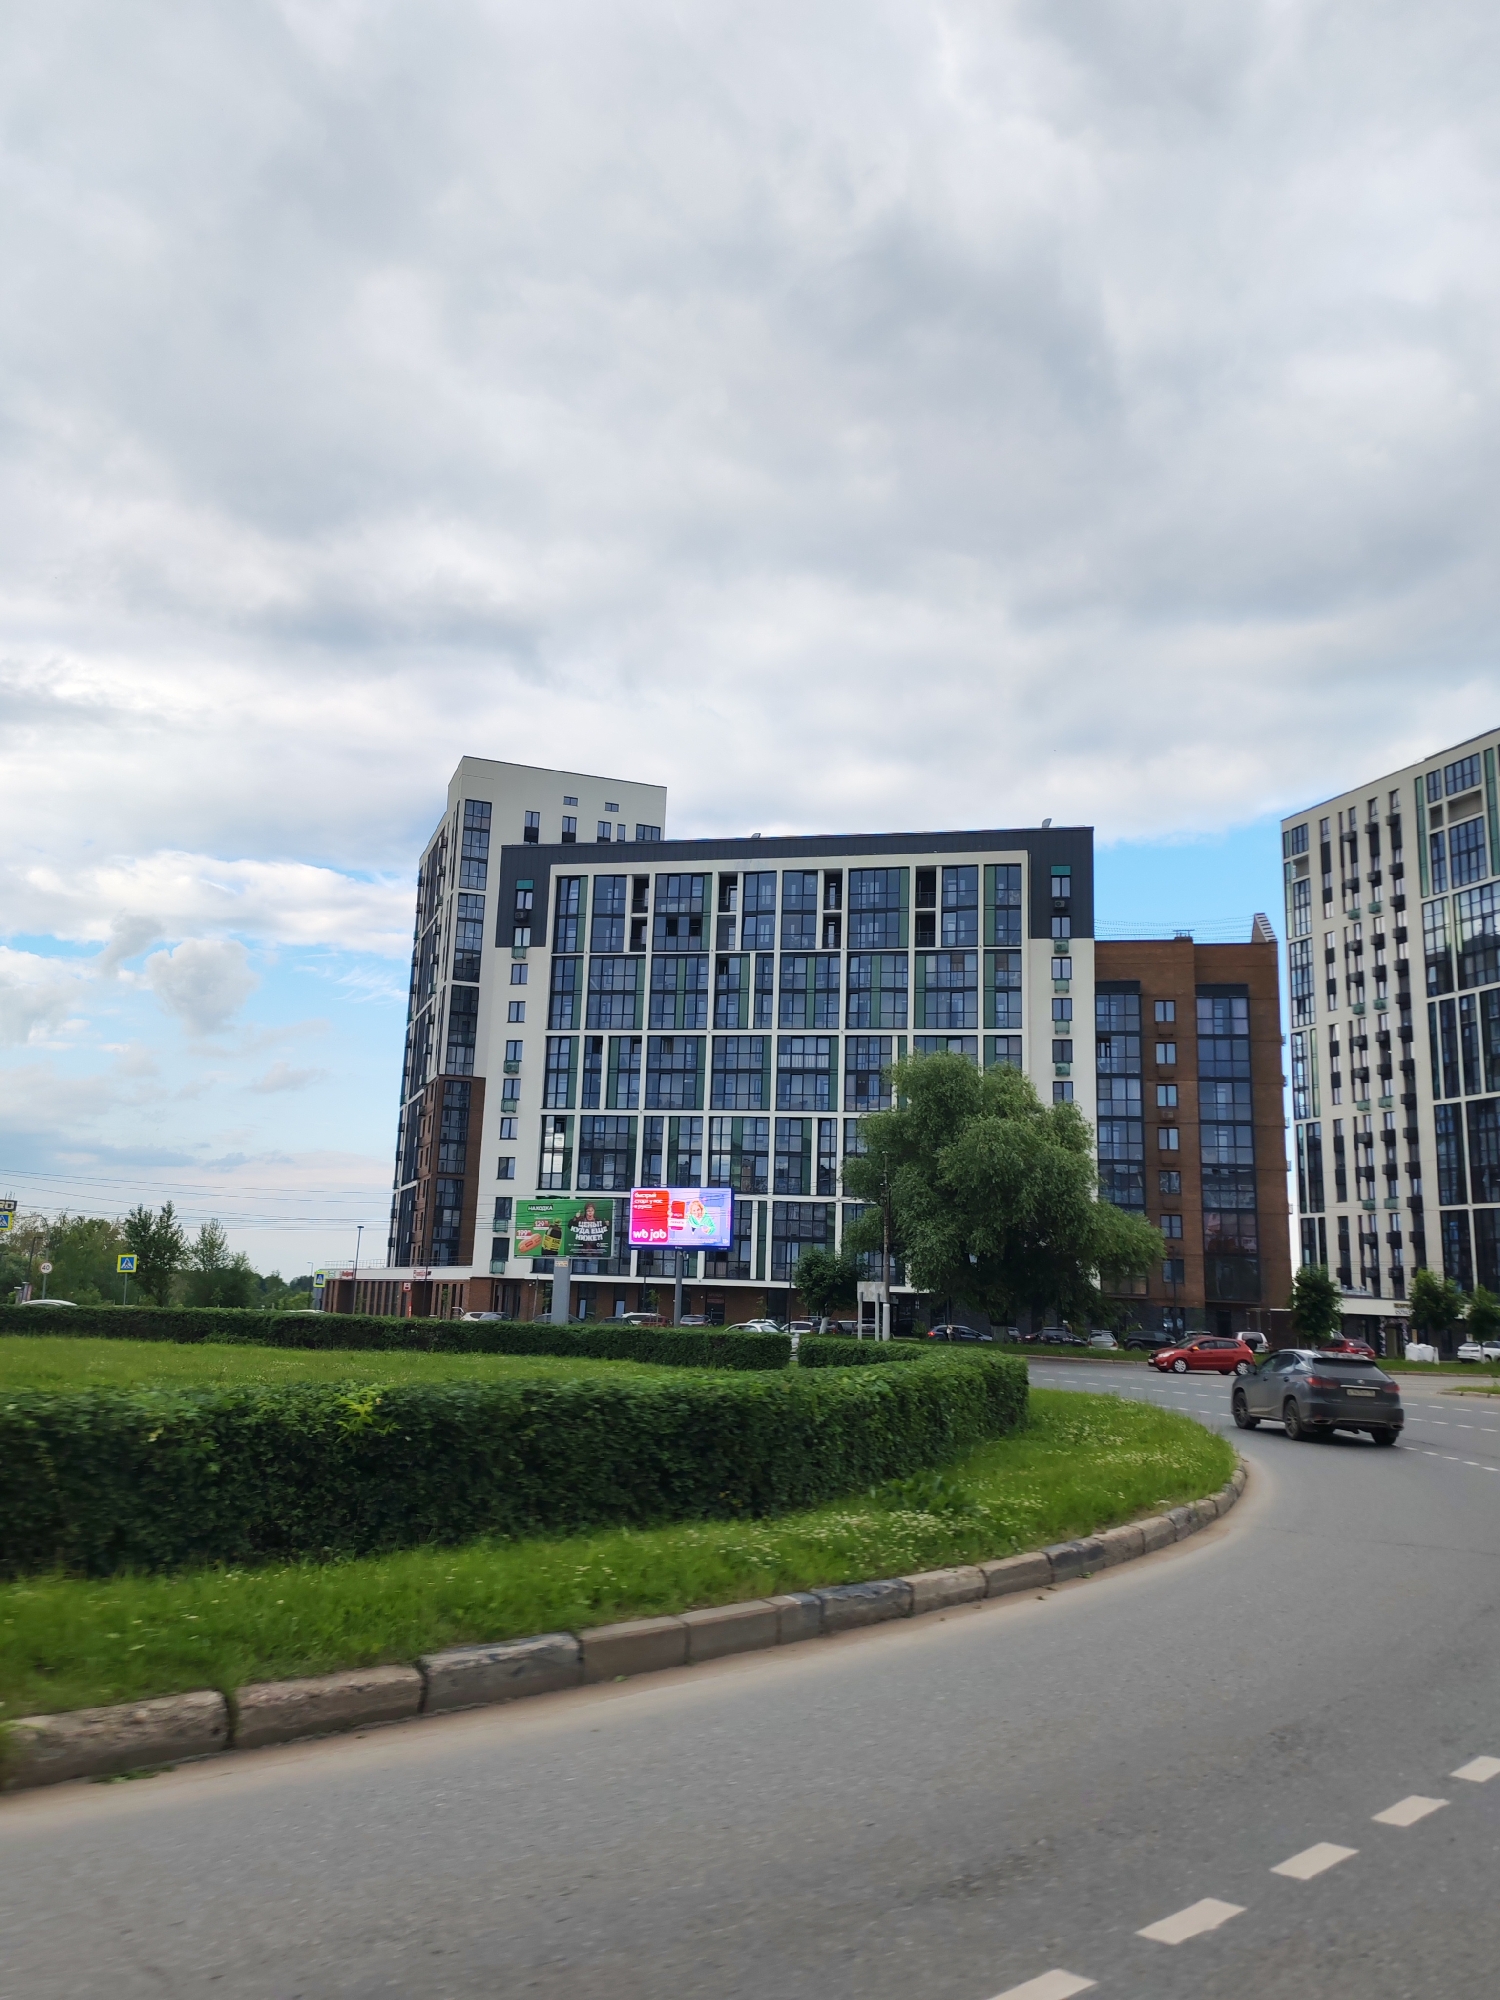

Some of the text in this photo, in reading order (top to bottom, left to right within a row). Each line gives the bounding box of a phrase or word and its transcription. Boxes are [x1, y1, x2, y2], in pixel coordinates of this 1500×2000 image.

[570, 1225, 590, 1234] КУДА
[575, 1233, 603, 1241] НИЖЕ?!
[632, 1228, 667, 1242] wb job
